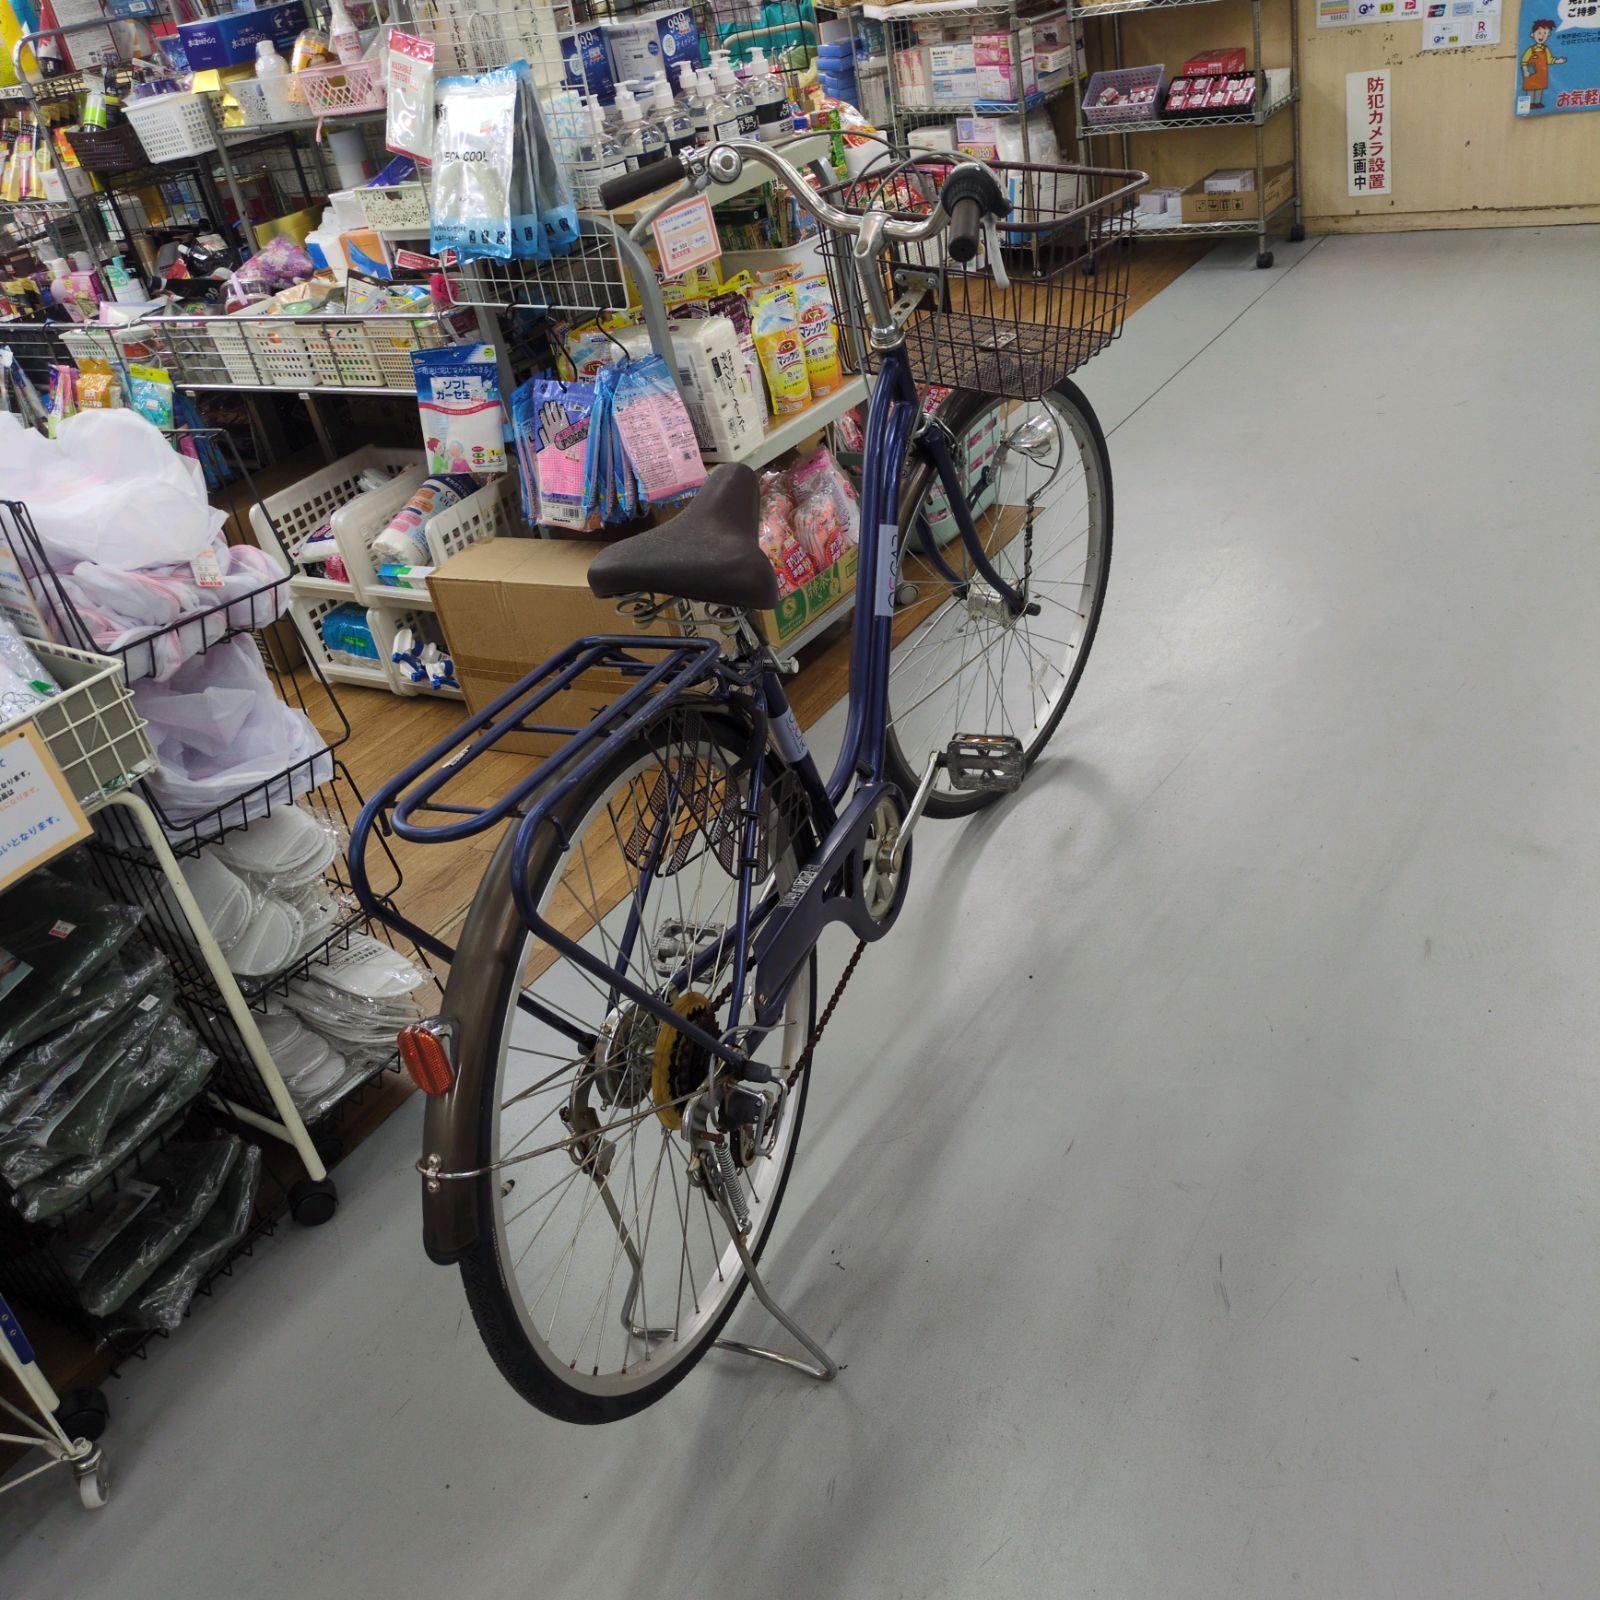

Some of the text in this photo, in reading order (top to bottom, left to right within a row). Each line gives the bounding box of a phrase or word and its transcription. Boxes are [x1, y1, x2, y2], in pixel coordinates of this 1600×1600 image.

[1568, 6, 1600, 17] ご持参
[1475, 32, 1487, 40] Edy
[1557, 89, 1600, 107] お気軽
[1367, 77, 1385, 190] 防犯カメラ設置
[1352, 142, 1367, 191] 録画中
[443, 380, 470, 390] ソフト
[436, 391, 471, 401] ガーゼ生
